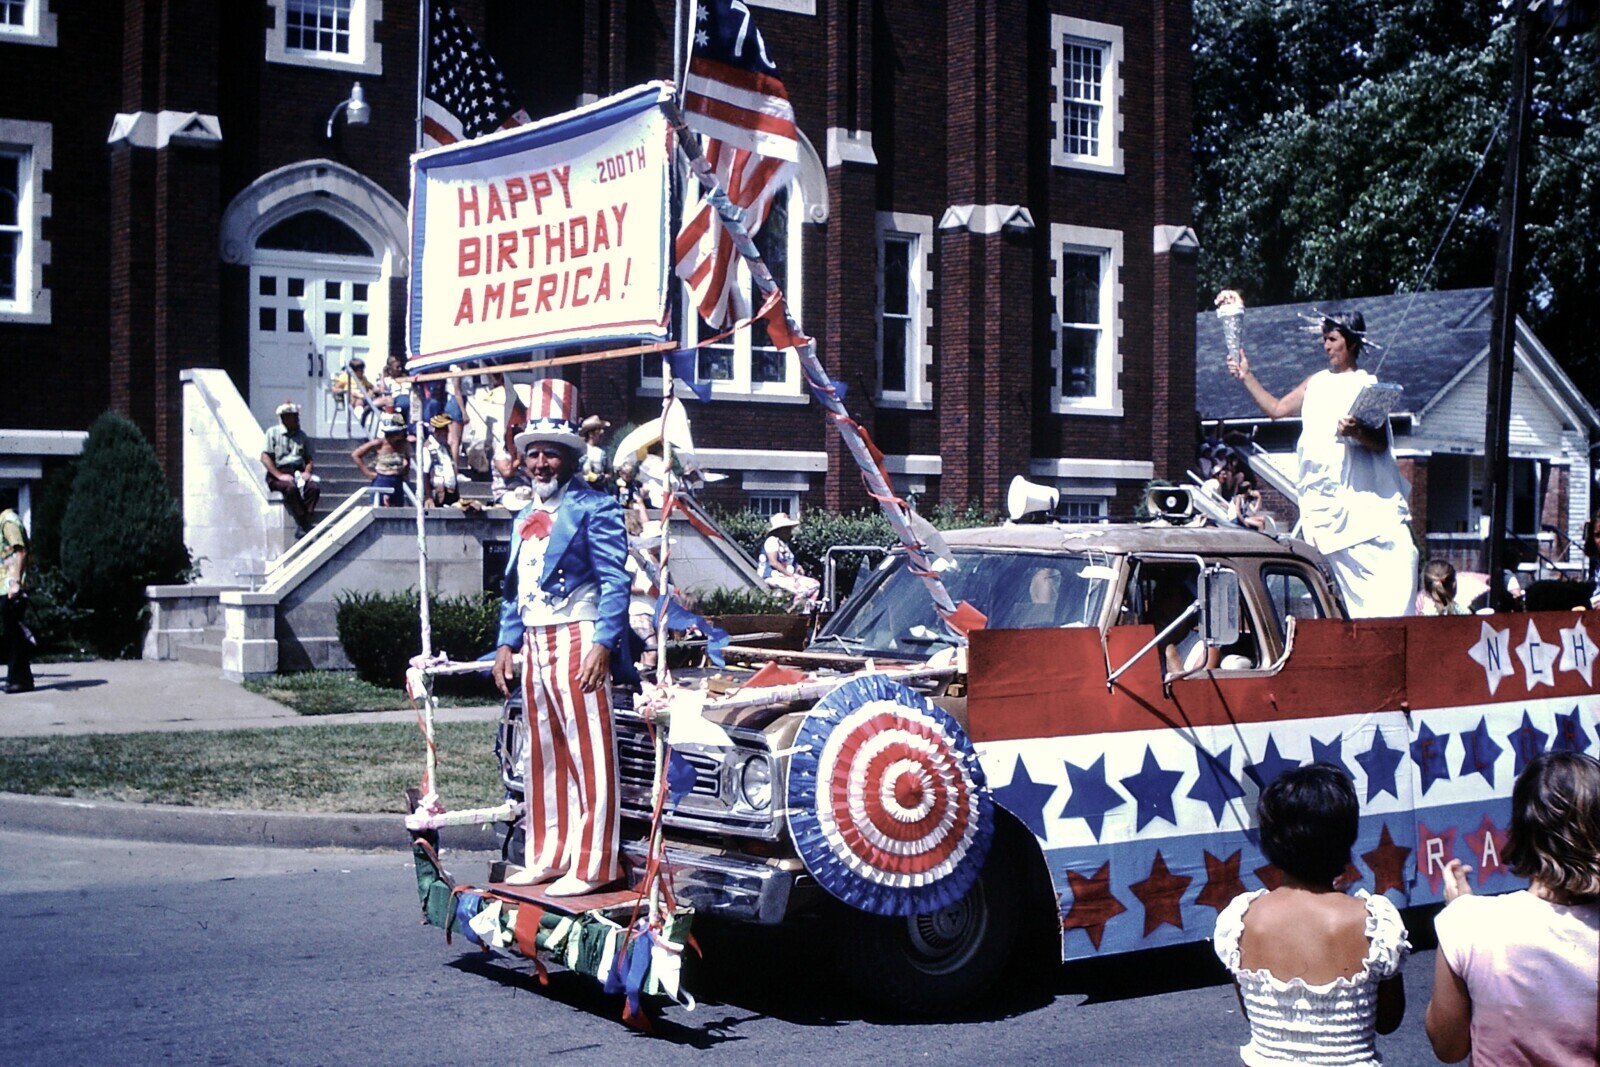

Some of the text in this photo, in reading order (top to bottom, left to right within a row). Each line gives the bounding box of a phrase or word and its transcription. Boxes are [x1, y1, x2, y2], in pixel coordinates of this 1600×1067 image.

[457, 146, 647, 228] HAPPY 200TH
[458, 202, 628, 277] BIRTHDAY
[454, 257, 632, 327] AMERICA!
